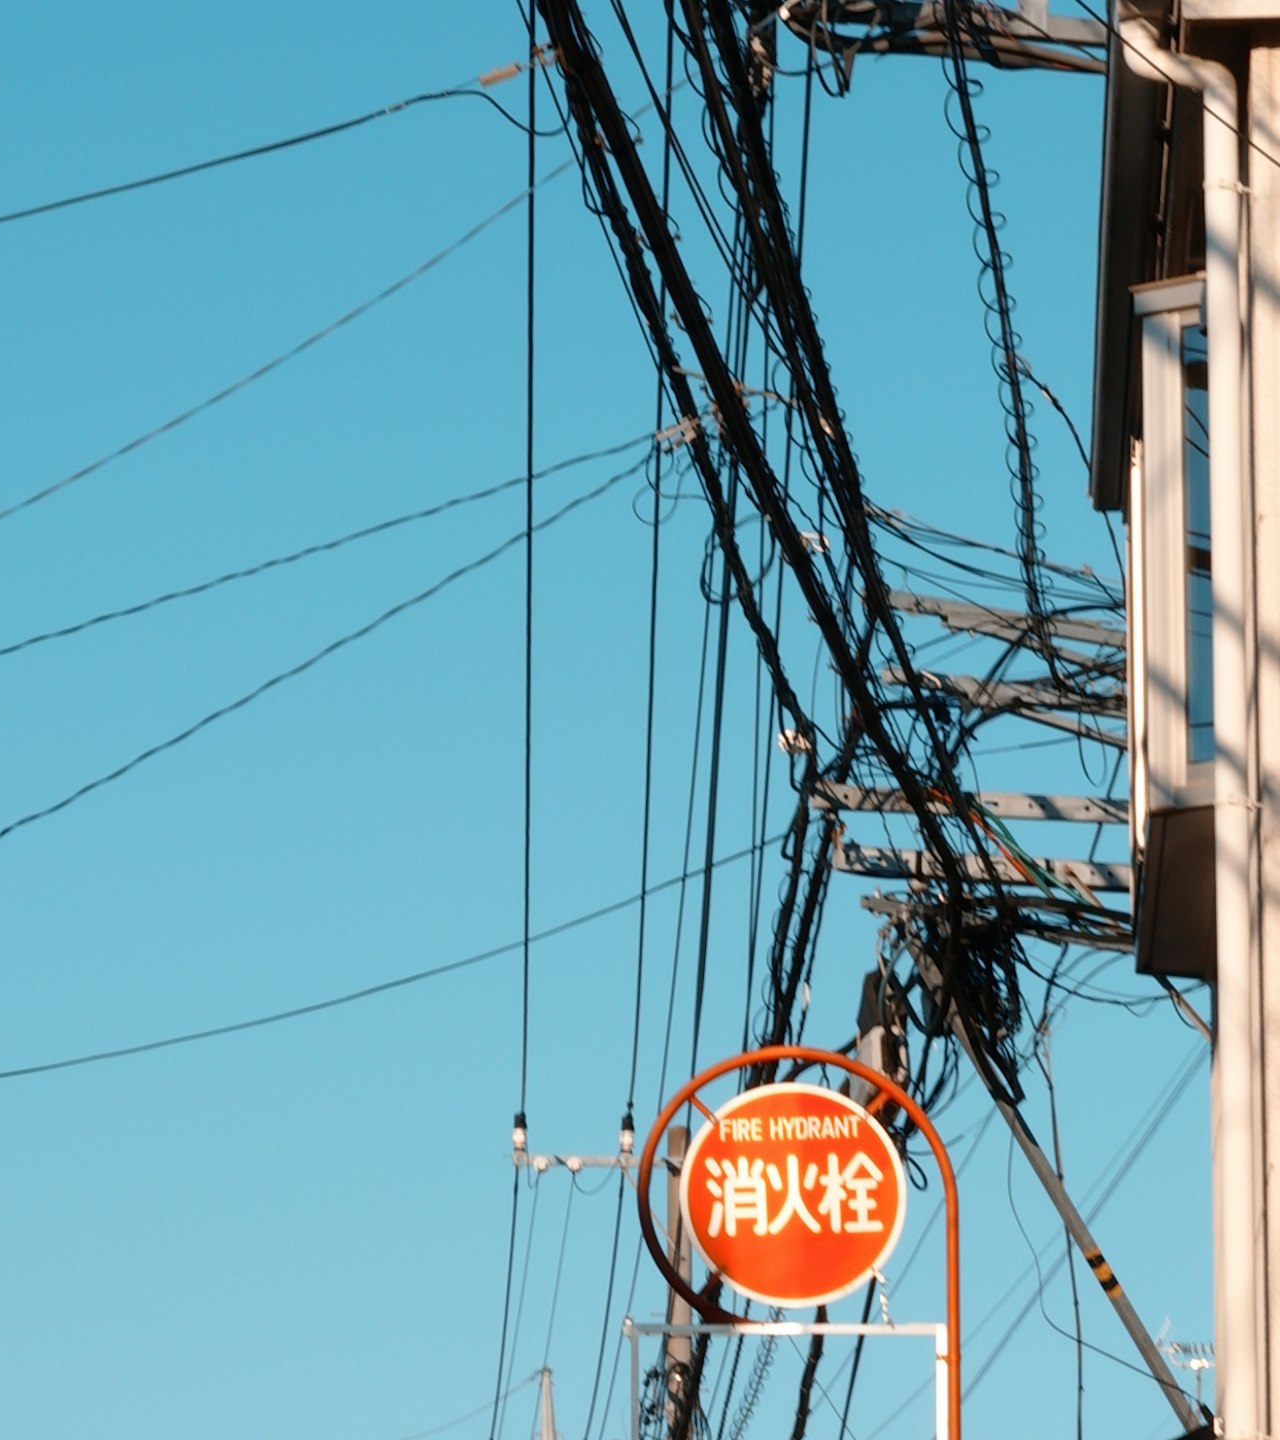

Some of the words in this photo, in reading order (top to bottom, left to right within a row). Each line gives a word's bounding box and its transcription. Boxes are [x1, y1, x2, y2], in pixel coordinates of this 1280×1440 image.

[719, 1117, 763, 1142] FIRE
[769, 1114, 861, 1141] HYDRANT
[704, 1151, 885, 1238] 消火栓
